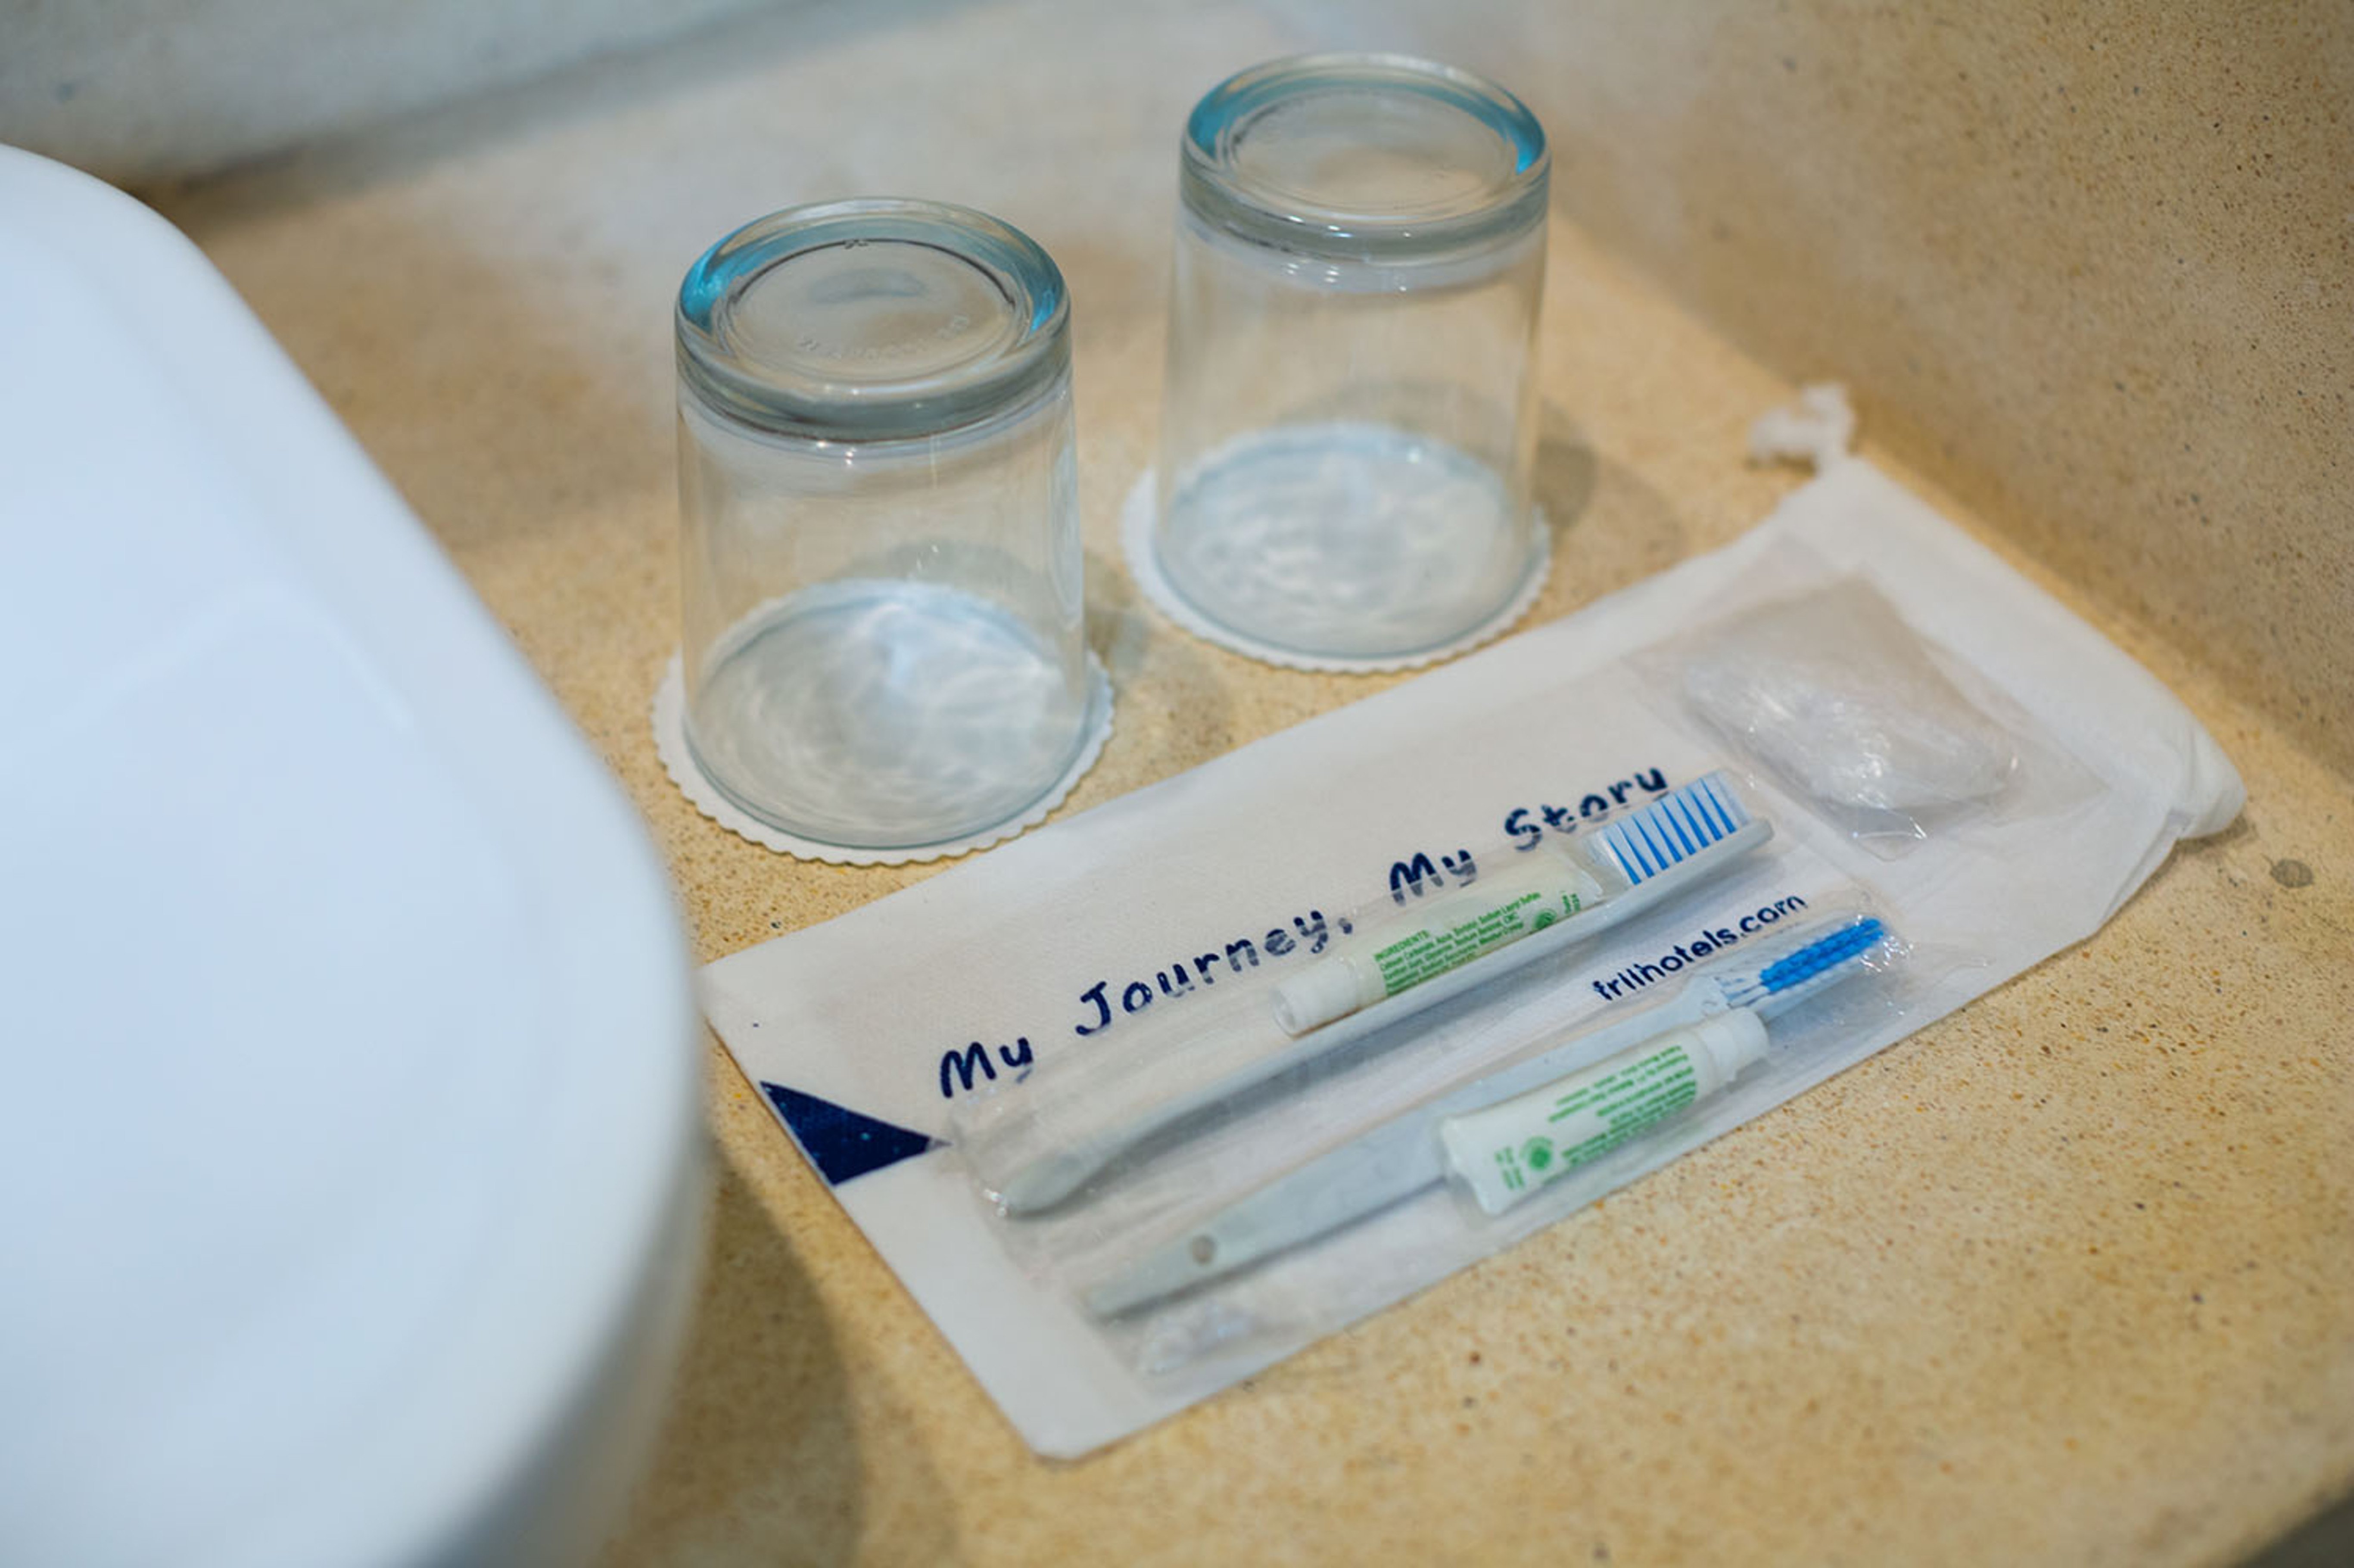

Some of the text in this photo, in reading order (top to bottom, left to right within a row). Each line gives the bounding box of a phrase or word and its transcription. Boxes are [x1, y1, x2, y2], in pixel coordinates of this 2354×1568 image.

[940, 1037, 1033, 1098] My
[1075, 910, 1353, 1036] Journey,
[1389, 849, 1477, 906] My
[1504, 767, 1669, 852] Story
